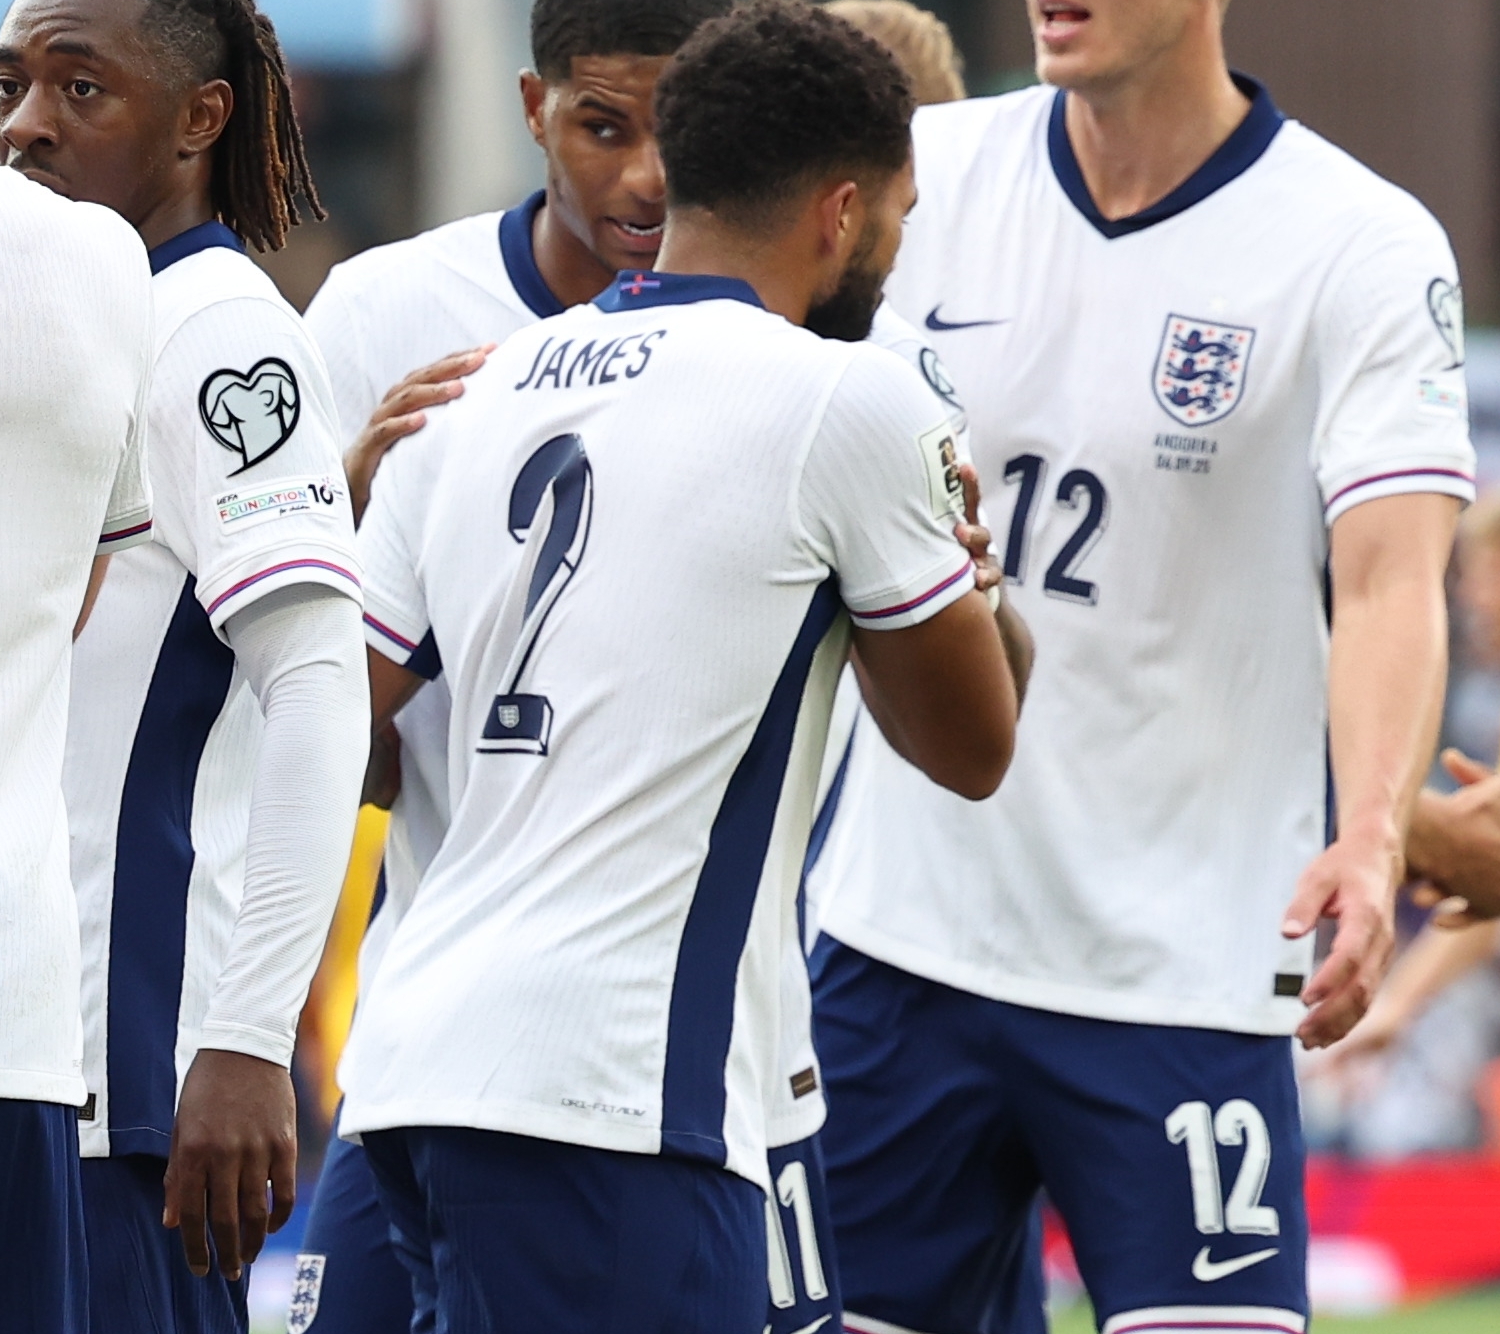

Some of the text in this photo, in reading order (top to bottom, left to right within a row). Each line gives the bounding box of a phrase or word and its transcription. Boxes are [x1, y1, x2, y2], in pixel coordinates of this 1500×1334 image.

[514, 329, 668, 393] JAMES
[216, 494, 239, 506] UEFA
[220, 490, 308, 521] FOUNDATION
[1003, 452, 1111, 605] 12
[476, 433, 594, 756] 2
[1164, 1098, 1280, 1237] 12
